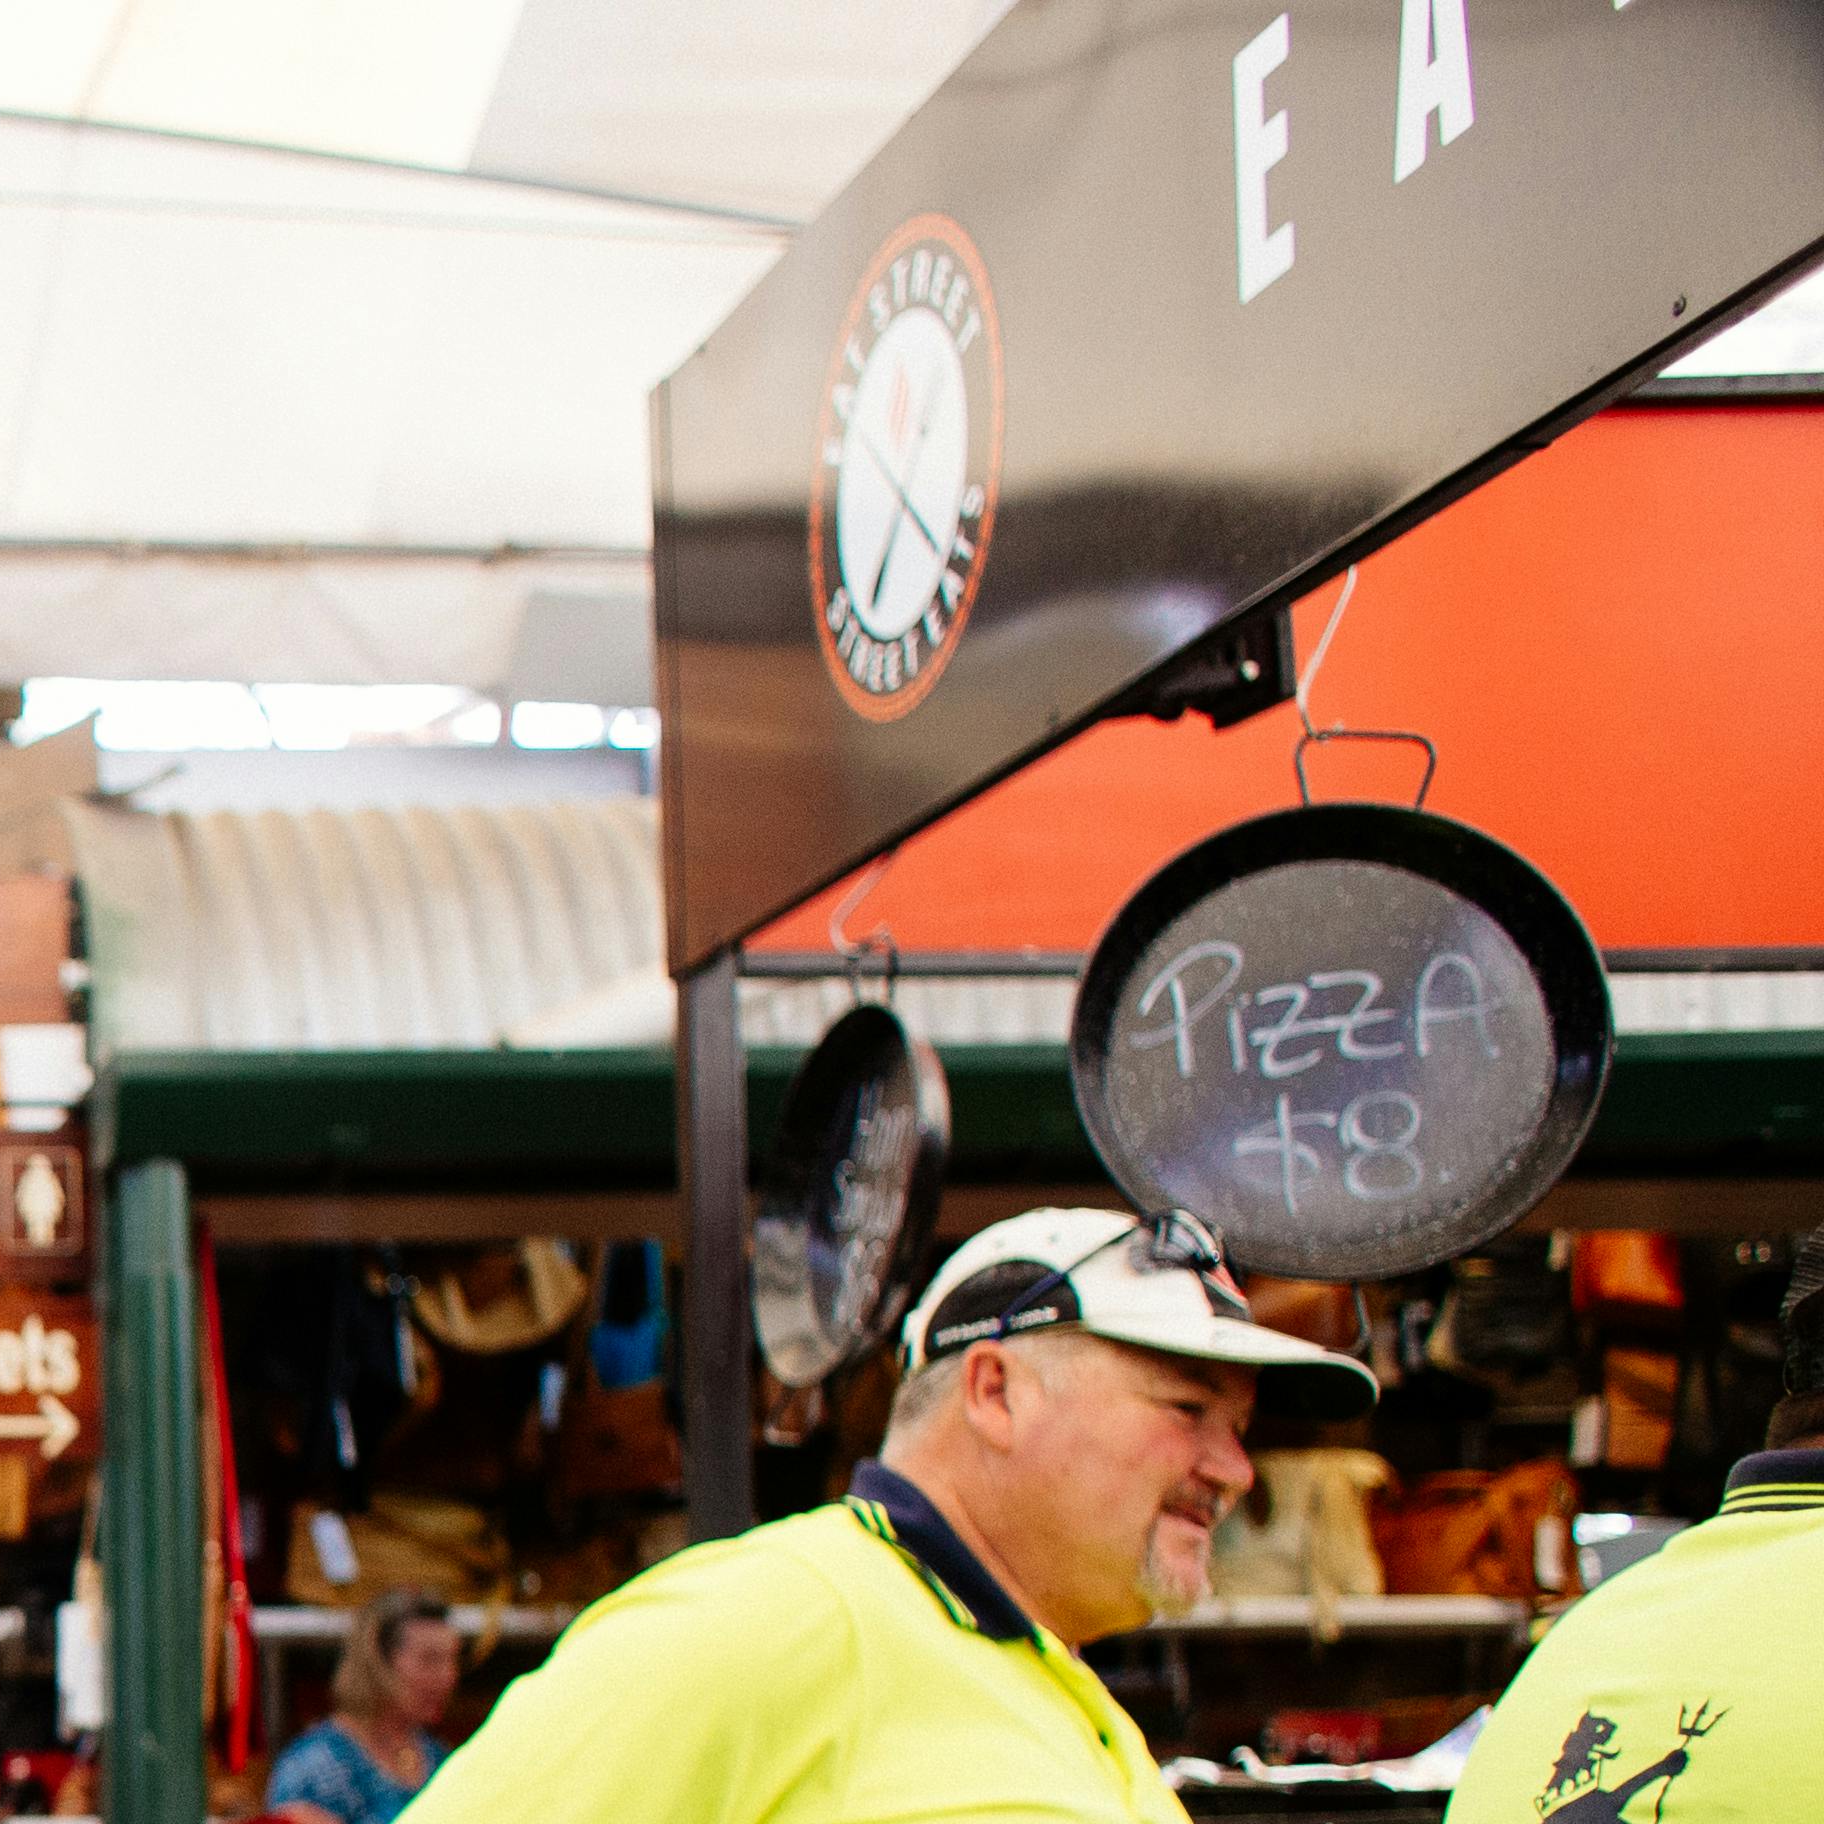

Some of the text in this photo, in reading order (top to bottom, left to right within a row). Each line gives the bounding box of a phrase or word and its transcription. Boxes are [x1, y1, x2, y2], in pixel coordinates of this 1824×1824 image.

[1232, 0, 1633, 305] EA
[868, 249, 982, 353] STREET
[826, 483, 985, 693] STREET EATS
